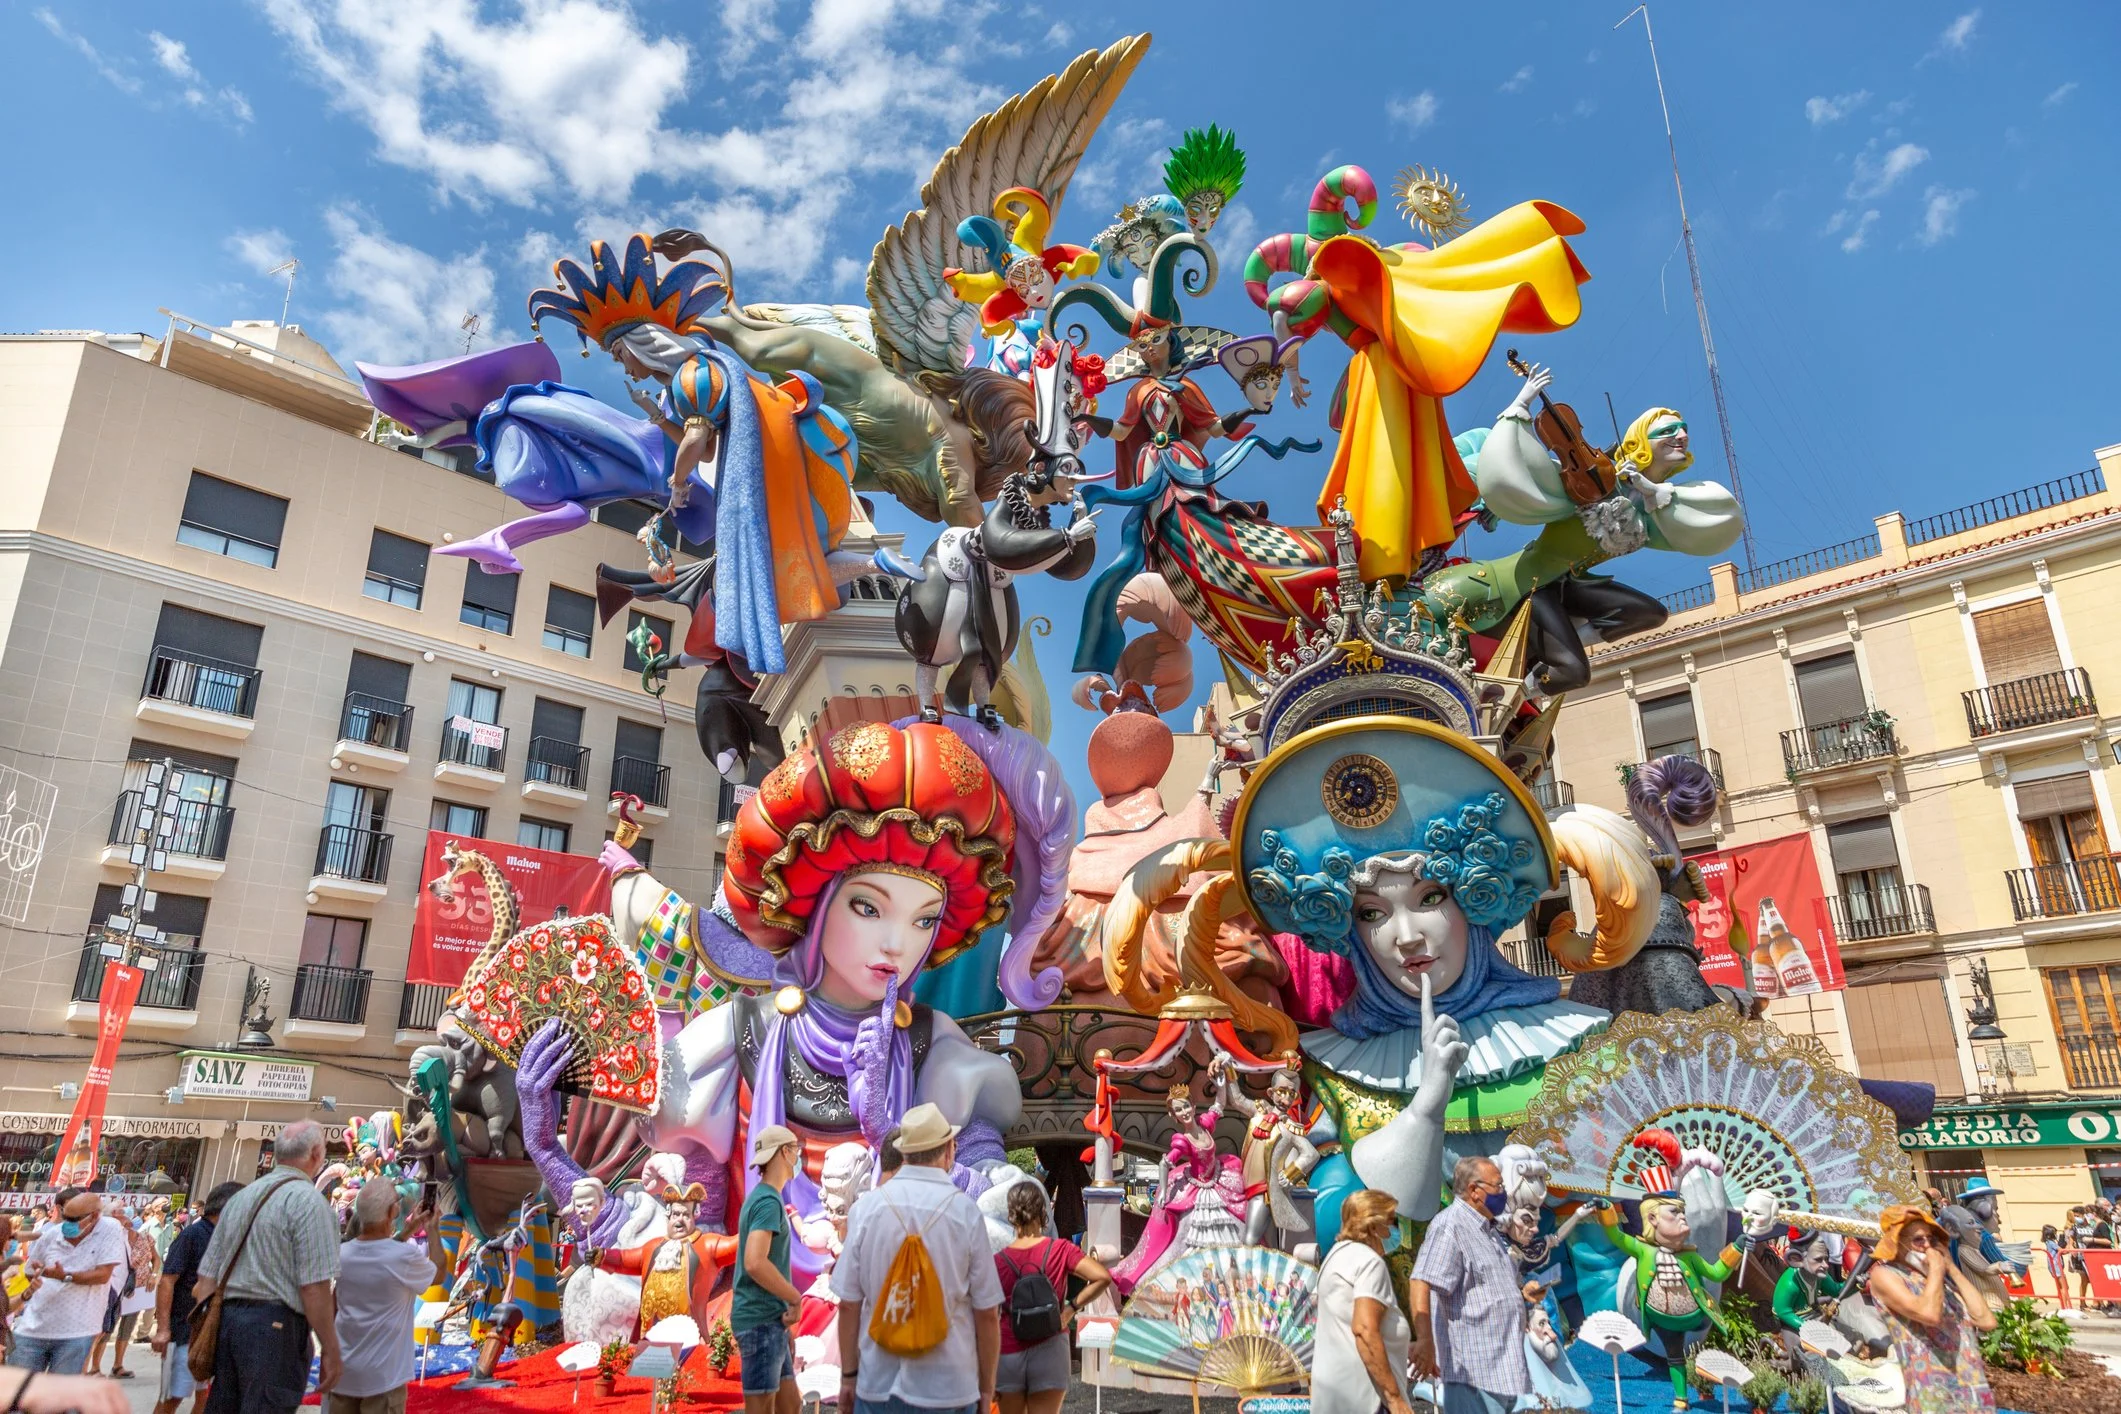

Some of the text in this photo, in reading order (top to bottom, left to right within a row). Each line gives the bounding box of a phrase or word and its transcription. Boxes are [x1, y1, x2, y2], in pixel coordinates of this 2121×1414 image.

[475, 727, 502, 738] VENDE
[506, 855, 541, 870] Mahou
[1699, 861, 1728, 873] ahou
[437, 881, 496, 924] 53
[435, 934, 444, 942] Lo
[445, 936, 466, 945] mejor
[466, 938, 476, 946] de
[442, 944, 463, 952] volver
[1698, 961, 1737, 971] ontrarnos.
[194, 1058, 247, 1086] SANZ
[265, 1064, 305, 1074] LIBRERIA
[261, 1072, 306, 1082] PAPELERIA
[257, 1080, 308, 1090] FOTOCOPIAS
[122, 1120, 201, 1134] INFORMATICA
[1899, 1128, 2041, 1147] ORATORIO
